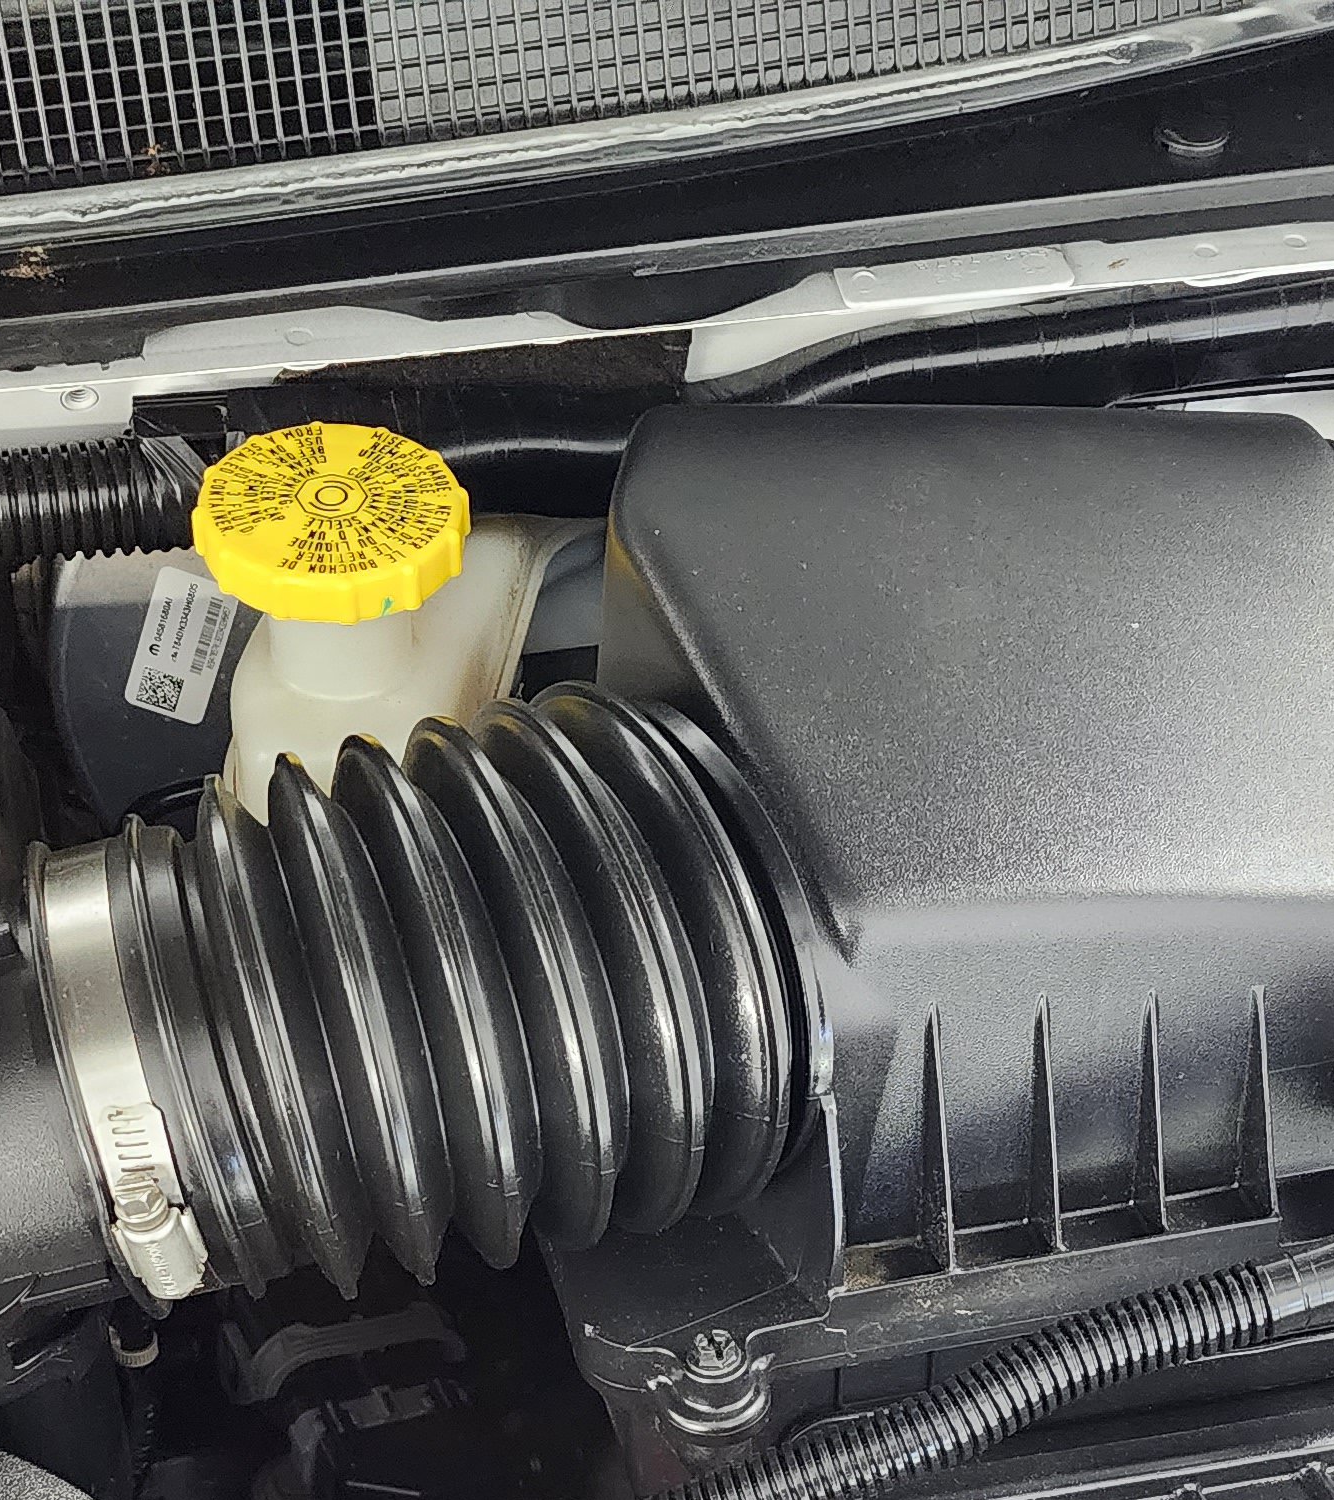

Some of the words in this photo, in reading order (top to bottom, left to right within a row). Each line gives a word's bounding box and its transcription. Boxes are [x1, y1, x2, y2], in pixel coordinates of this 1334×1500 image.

[262, 434, 279, 445] A
[279, 424, 323, 441] FROM
[292, 435, 324, 447] USE
[369, 429, 409, 449] MISE
[217, 441, 264, 475] SEALED
[249, 443, 287, 465] ONLY
[265, 444, 325, 469] BEFORE
[284, 454, 327, 472] CLEAN
[406, 447, 430, 462] EN
[356, 448, 411, 479] UTILISER
[360, 460, 389, 477] DOT
[368, 440, 436, 494] REMPLISSAGE
[229, 465, 254, 484] DOT
[380, 477, 398, 486] 3
[259, 470, 287, 502] FILLER
[345, 466, 386, 518] CONTENANT
[261, 505, 286, 524] CAP
[352, 488, 403, 539] PROVENANT
[377, 481, 419, 540] UNIQUEMENT
[407, 501, 435, 532] AVANT
[406, 504, 452, 552] NETTOYER
[285, 535, 351, 553] LIQUIDE
[356, 535, 378, 549] DU
[391, 531, 414, 546] DE
[369, 542, 393, 556] LE
[383, 549, 407, 564] LE
[275, 556, 298, 571] DE
[306, 558, 379, 574] BOUCHON
